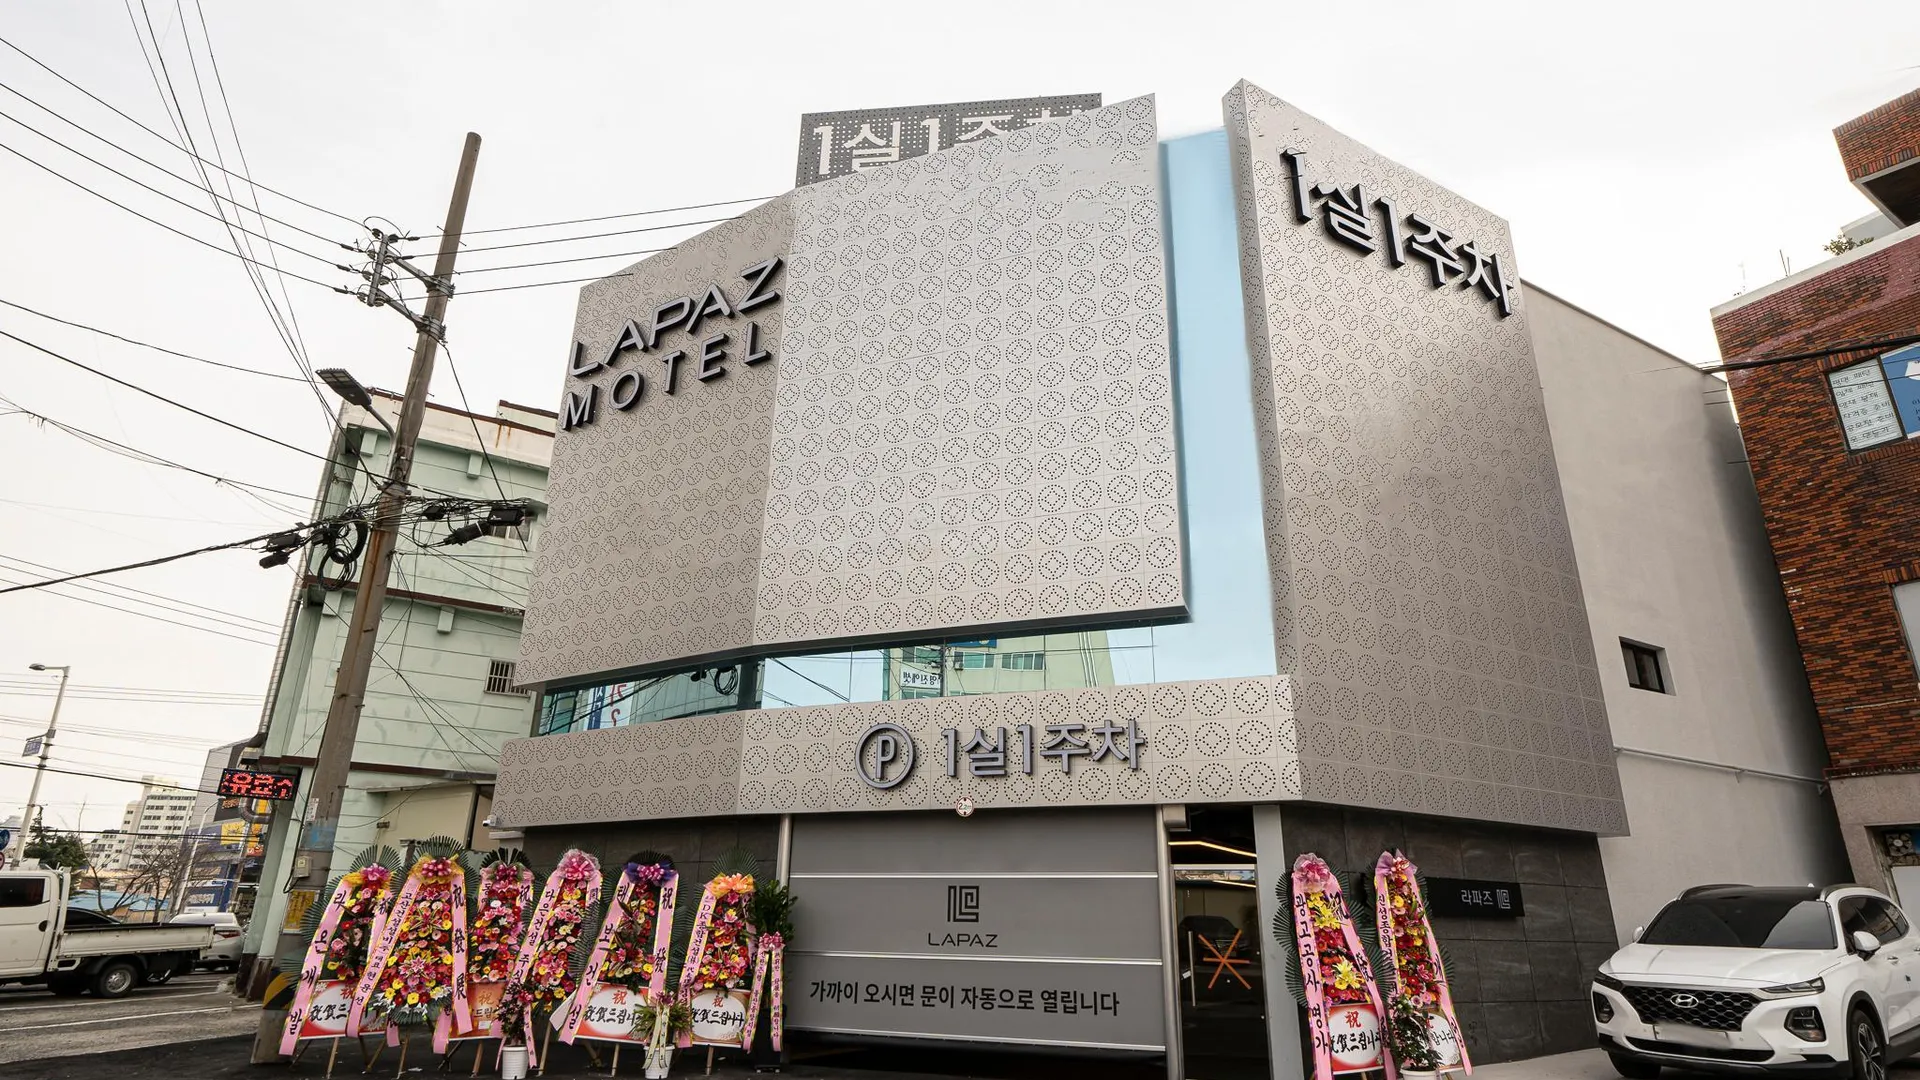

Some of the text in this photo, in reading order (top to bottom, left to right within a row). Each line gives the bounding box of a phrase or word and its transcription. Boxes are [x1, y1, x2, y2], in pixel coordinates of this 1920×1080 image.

[1280, 147, 1514, 318] 1실1주차
[569, 257, 783, 378] LAPAZ
[562, 321, 772, 431] MOTEL
[941, 719, 1145, 777] 1실1주차
[1460, 889, 1493, 906] 라파즈
[928, 933, 998, 948] LAPAZ
[611, 990, 628, 1006] 祝
[712, 994, 725, 1009] 祝
[810, 980, 1120, 1016] 가까이 오시면 문이 자동으로 열립니다
[1345, 1011, 1362, 1028] 祝
